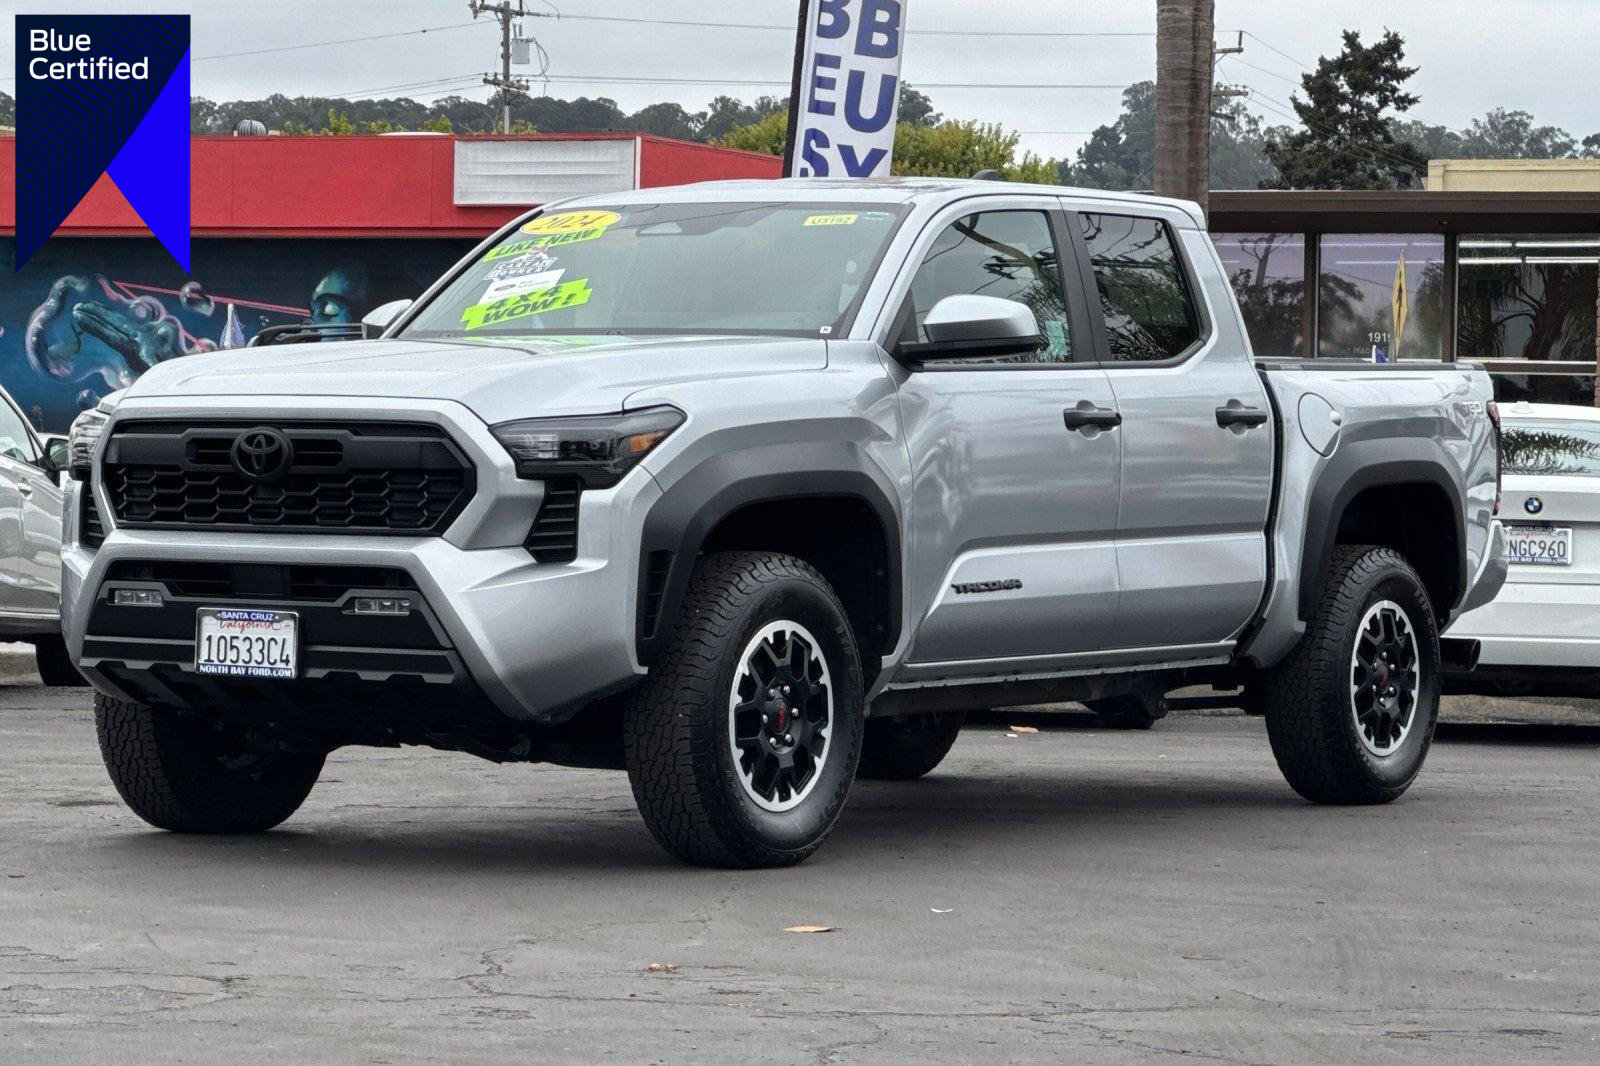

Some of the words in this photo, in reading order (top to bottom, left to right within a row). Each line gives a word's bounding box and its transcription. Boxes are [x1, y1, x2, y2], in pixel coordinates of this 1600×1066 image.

[528, 214, 610, 232] 2024
[494, 238, 546, 256] LIKE
[545, 227, 601, 245] NEW
[1505, 540, 1566, 558] NGC960
[951, 579, 1023, 595] TACOMA
[221, 611, 249, 620] SANTA
[250, 612, 274, 621] CRUZ
[219, 619, 277, 634] California
[203, 634, 291, 667] 10533C4
[200, 663, 228, 674] NORTH
[230, 665, 246, 675] BAY
[248, 666, 291, 678] FORD.COM
